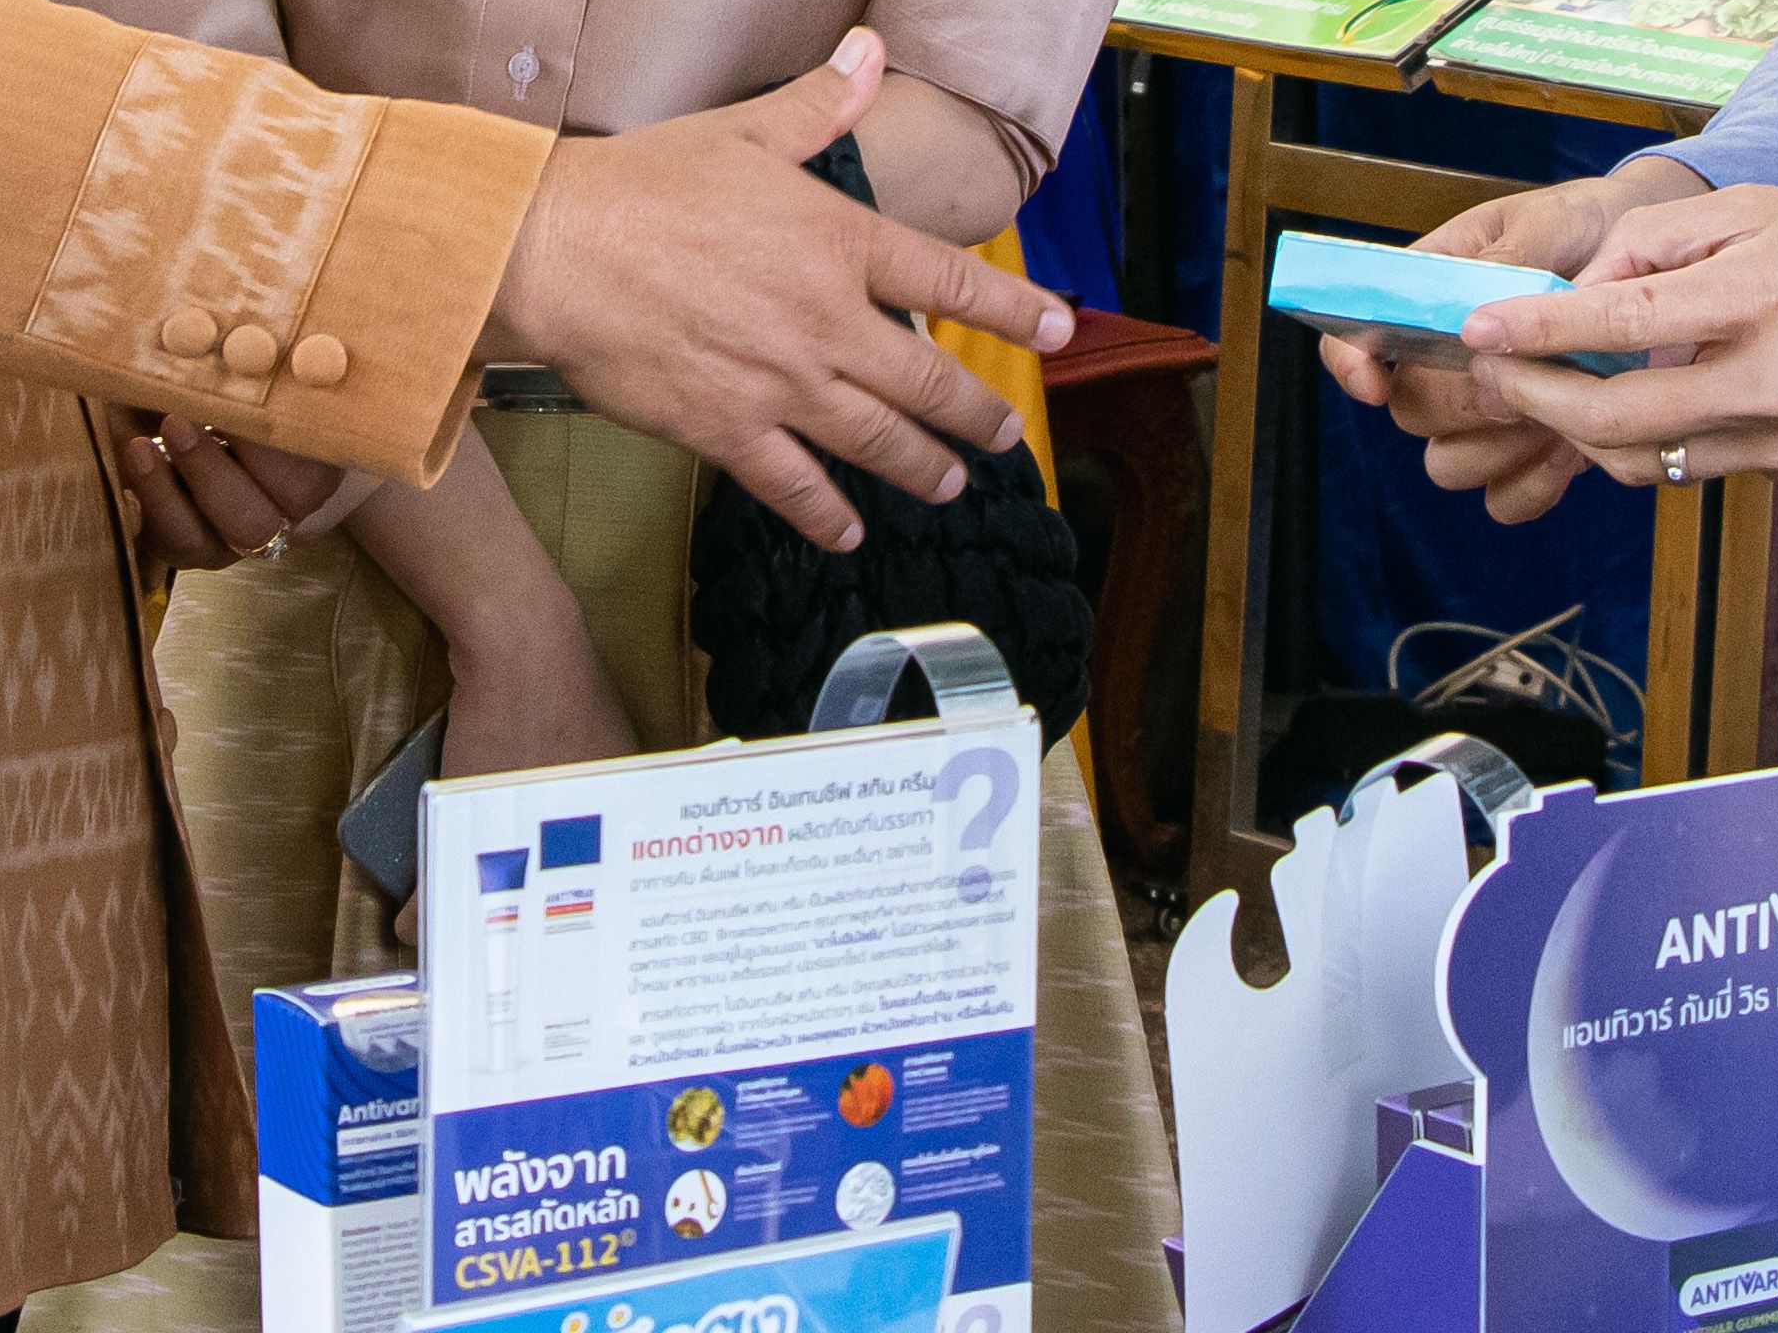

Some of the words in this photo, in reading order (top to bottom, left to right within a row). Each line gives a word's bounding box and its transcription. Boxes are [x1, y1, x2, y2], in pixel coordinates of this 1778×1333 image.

[631, 824, 784, 861] แตกต่างจาก
[1562, 996, 1674, 1050] แอนทิวาร์
[1679, 978, 1731, 1027] กัมมี่
[1738, 983, 1770, 1017] วิธ
[454, 1144, 628, 1206] พลังจาก
[454, 1189, 640, 1248] สารสกัดหลัก
